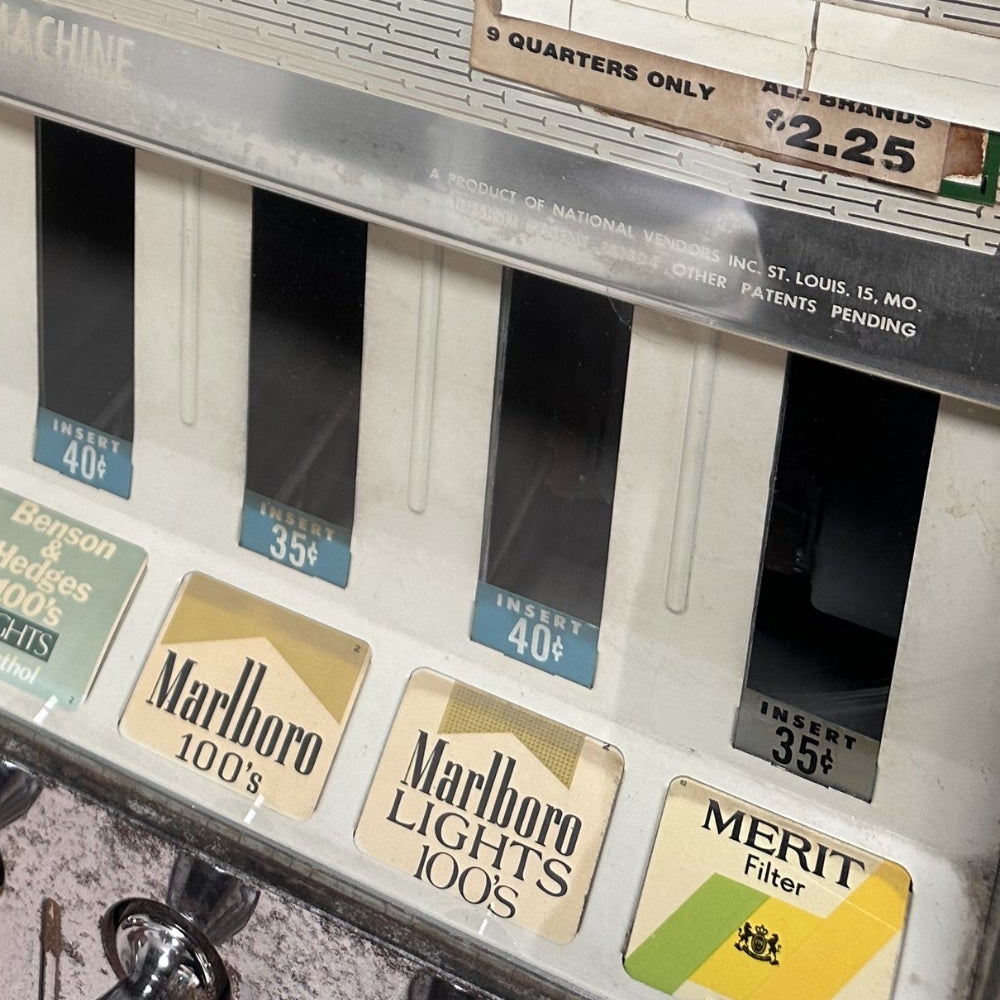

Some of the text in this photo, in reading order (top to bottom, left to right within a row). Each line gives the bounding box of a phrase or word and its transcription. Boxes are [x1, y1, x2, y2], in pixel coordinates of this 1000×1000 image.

[486, 26, 716, 101] 9 QUARTERS ONLY
[819, 94, 932, 128] BRANDS
[766, 108, 915, 173] $2.25
[429, 167, 439, 179] A
[448, 173, 517, 204] PRODUCT
[525, 196, 545, 211] OF
[553, 203, 635, 239] NATIONAL
[643, 229, 720, 263] VENDORS
[729, 254, 761, 275] INC.
[768, 265, 790, 282] ST.
[857, 285, 878, 304] 15,
[884, 291, 922, 313] MO.
[671, 262, 917, 338] OTHER PATENTS PENDING
[52, 418, 121, 454] INSERT
[63, 441, 106, 480] 40¢
[10, 498, 117, 561] Benson
[259, 501, 335, 542] INSERT
[269, 522, 318, 567] 35¢
[39, 541, 62, 561] &
[496, 593, 582, 635] INSERT
[508, 617, 564, 663] 40¢
[145, 649, 324, 776] Marlboro
[760, 701, 858, 751] INSERT
[175, 732, 264, 795] 100's
[772, 726, 834, 776] 35¢
[400, 728, 583, 857] Marlboro
[386, 788, 572, 898] LIGHTS
[701, 798, 866, 889] MERIT
[744, 853, 806, 897] Filter
